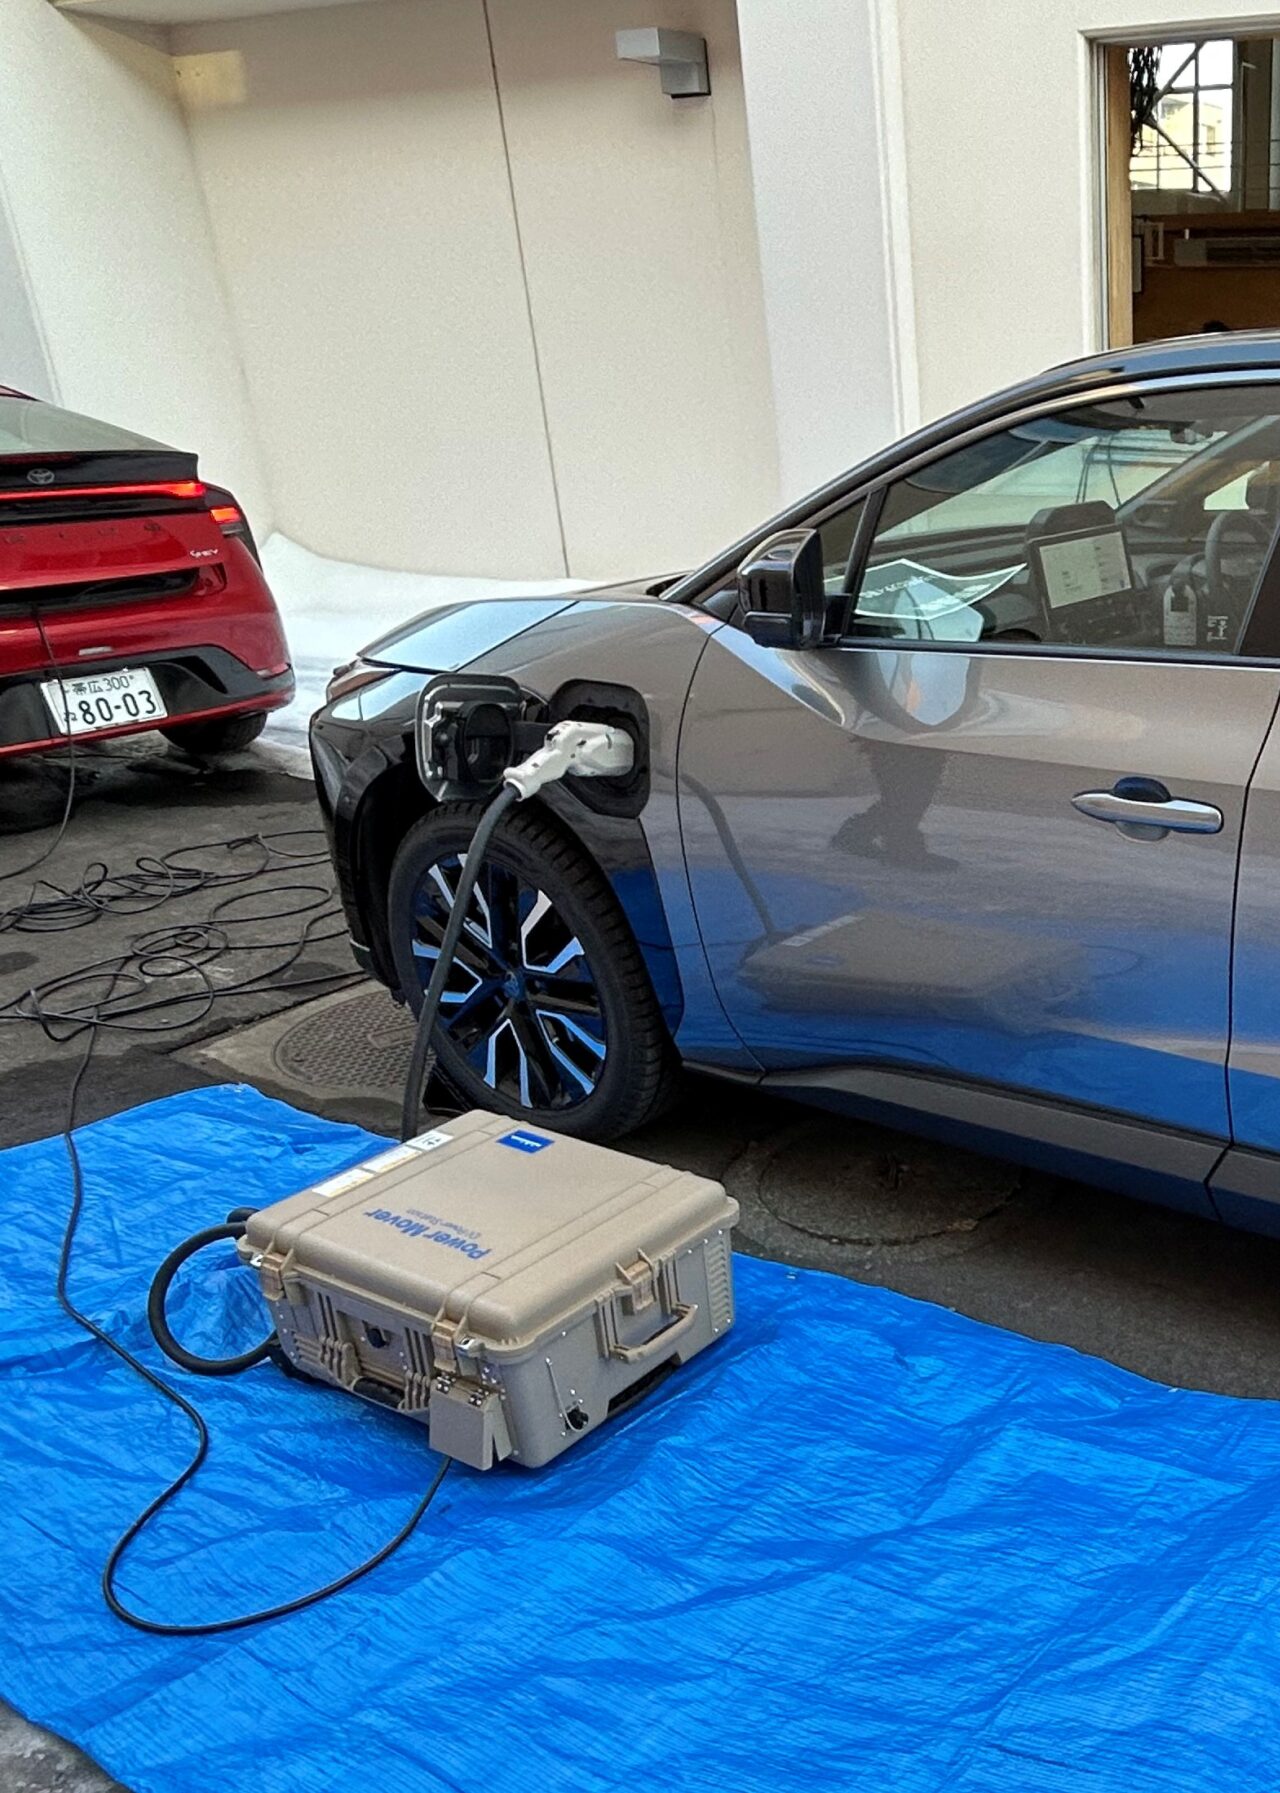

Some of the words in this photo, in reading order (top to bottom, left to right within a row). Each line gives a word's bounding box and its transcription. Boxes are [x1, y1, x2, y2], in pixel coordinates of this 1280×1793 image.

[103, 675, 131, 692] 300
[78, 690, 157, 725] 80-03
[363, 1208, 431, 1237] Mover
[423, 1230, 492, 1260] Power
